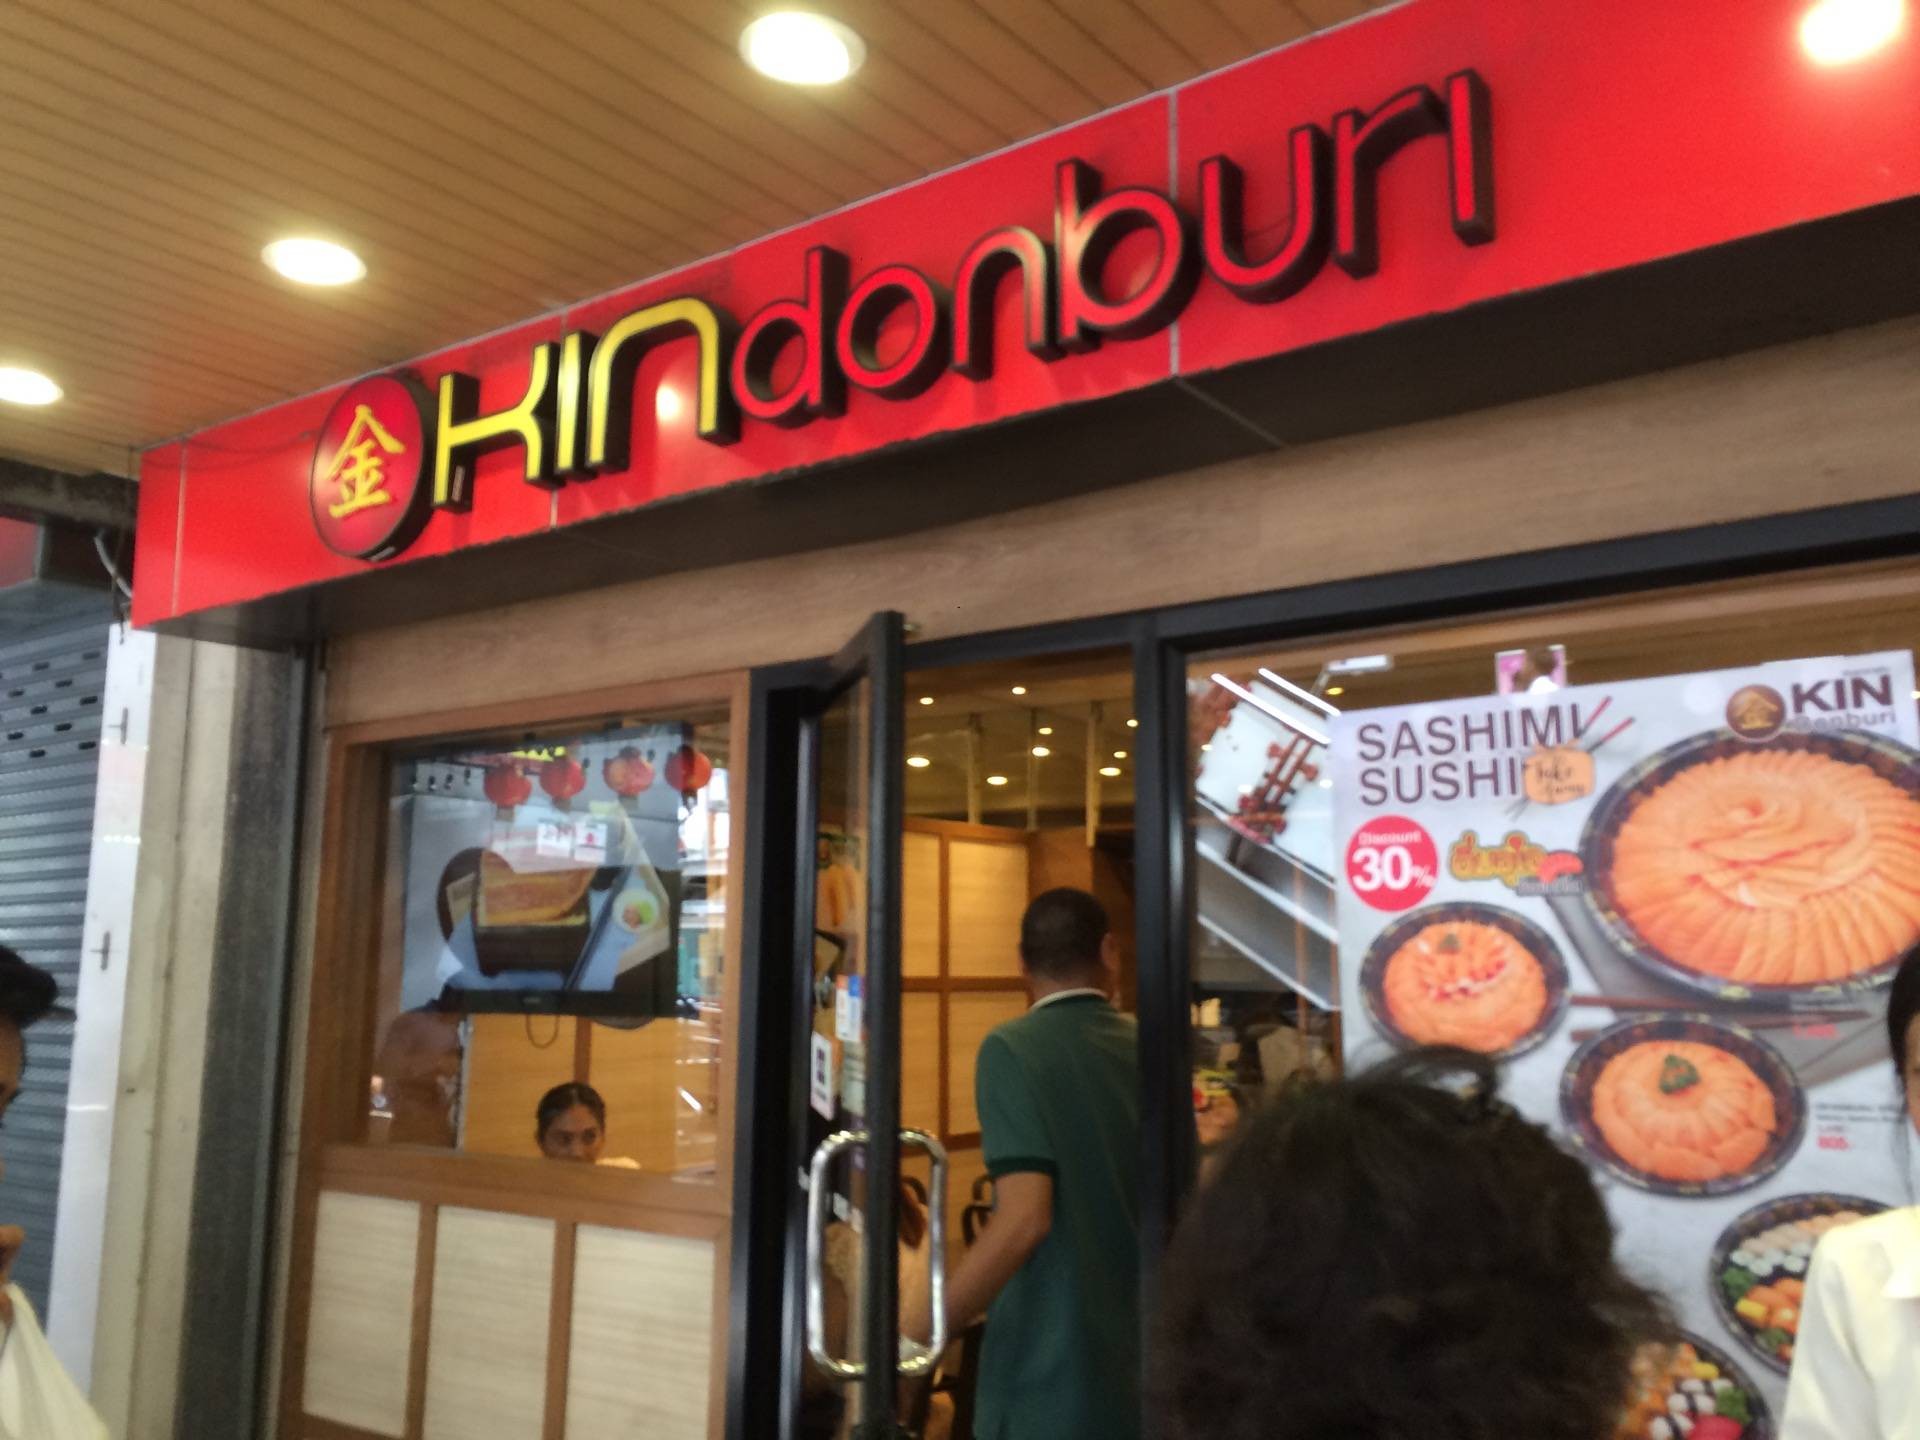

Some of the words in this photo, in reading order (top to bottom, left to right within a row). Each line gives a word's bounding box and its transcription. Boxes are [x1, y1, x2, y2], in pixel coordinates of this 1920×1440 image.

[325, 404, 406, 518] 金
[1792, 674, 1892, 713] KIN
[1358, 702, 1581, 763] SASHIMI
[1360, 756, 1518, 806] SUSHI
[1351, 845, 1435, 892] 30%
